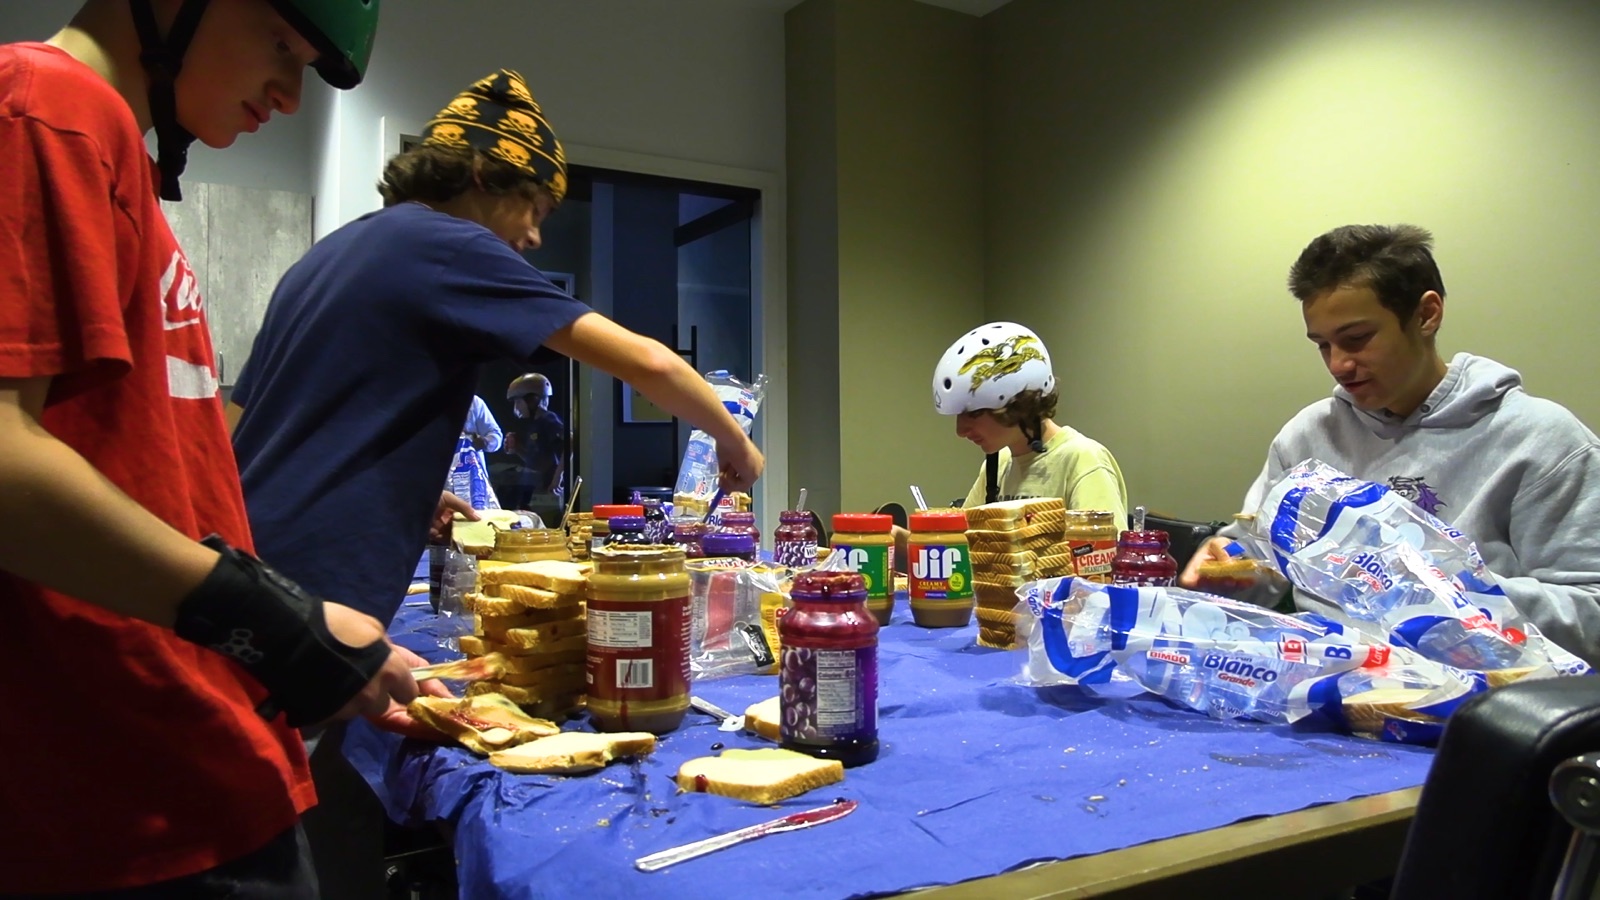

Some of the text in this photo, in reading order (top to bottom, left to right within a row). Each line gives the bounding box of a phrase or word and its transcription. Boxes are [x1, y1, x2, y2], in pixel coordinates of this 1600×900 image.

[912, 548, 962, 579] Jif
[1349, 552, 1394, 591] Blanco
[1150, 651, 1187, 664] BIMBO
[1370, 644, 1387, 665] Larg
[1204, 654, 1278, 683] Blanco
[1217, 672, 1256, 688] Grande
